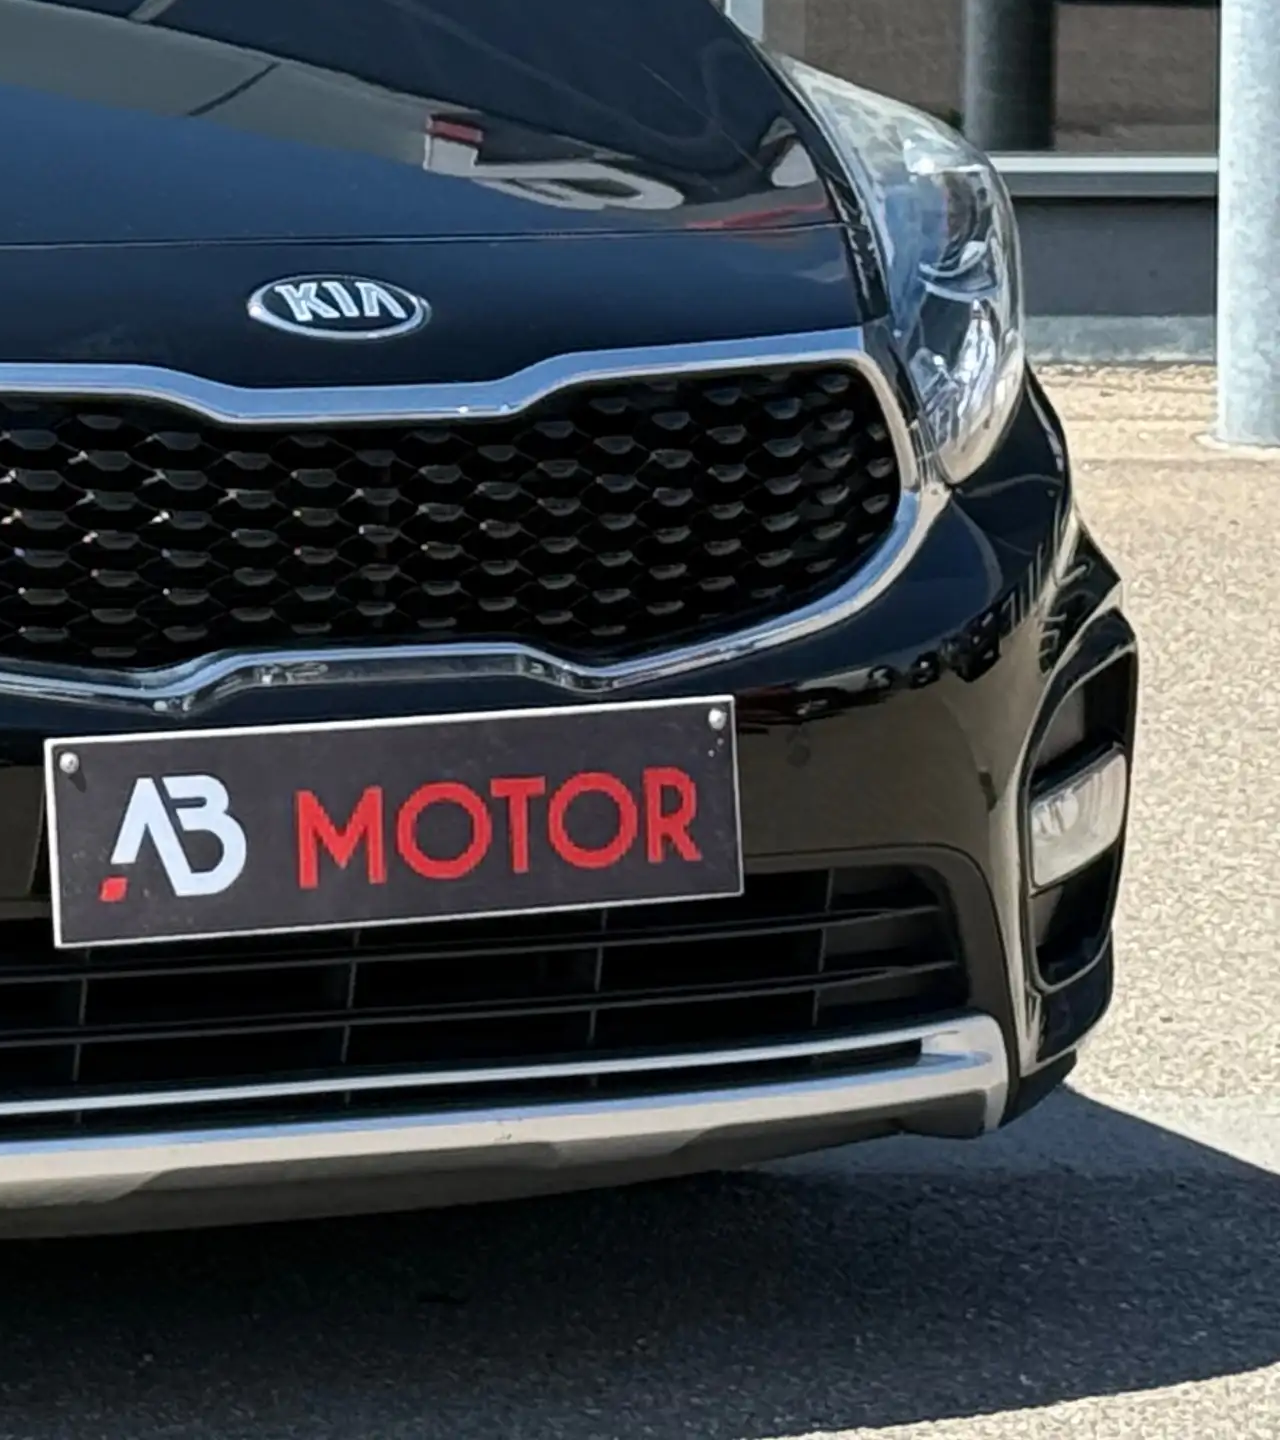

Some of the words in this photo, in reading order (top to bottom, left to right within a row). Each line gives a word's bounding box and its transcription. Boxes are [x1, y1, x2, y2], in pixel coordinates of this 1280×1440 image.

[273, 280, 408, 322] KIA
[101, 773, 248, 901] AB
[294, 766, 702, 890] MOTOR
